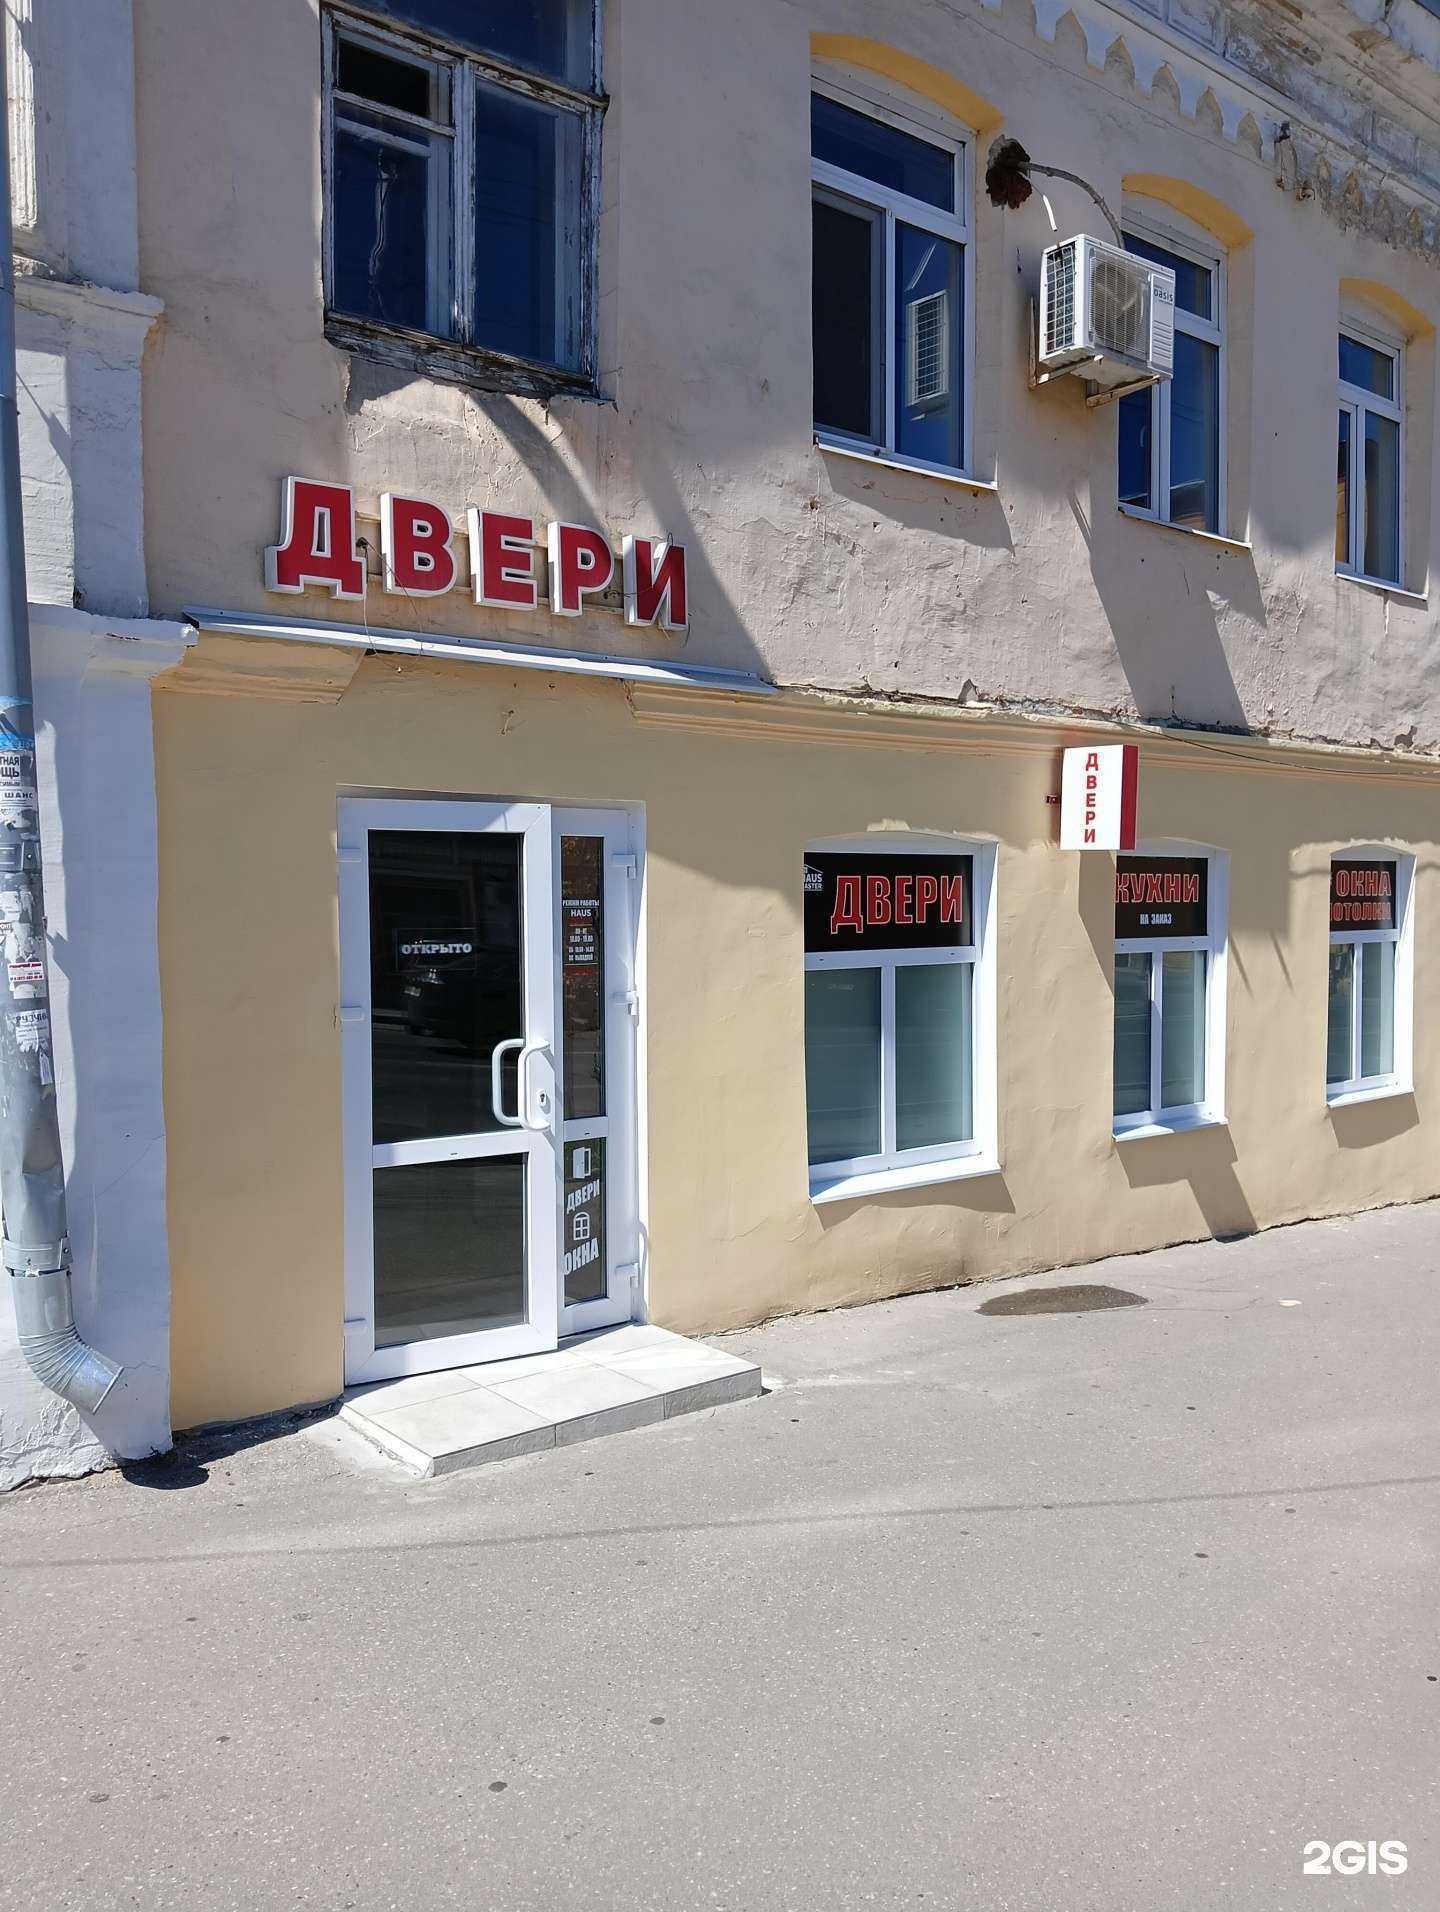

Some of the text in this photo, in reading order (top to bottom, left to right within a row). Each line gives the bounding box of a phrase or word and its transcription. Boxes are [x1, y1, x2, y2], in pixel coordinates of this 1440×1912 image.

[264, 475, 689, 631] ДВЕРИ
[1084, 752, 1099, 843] ДВЕРИ
[803, 873, 823, 883] AUS
[1115, 872, 1200, 903] КУХНИ
[1335, 869, 1392, 897] ОКНА
[570, 909, 592, 917] HAUS
[830, 875, 963, 935] ДВЕРИ
[1139, 913, 1172, 925] НА ЗАКАЗ
[401, 943, 473, 955] ОТКРЫТО
[566, 1178, 600, 1215] ДВЕРИ
[563, 1236, 600, 1276] ОКНА
